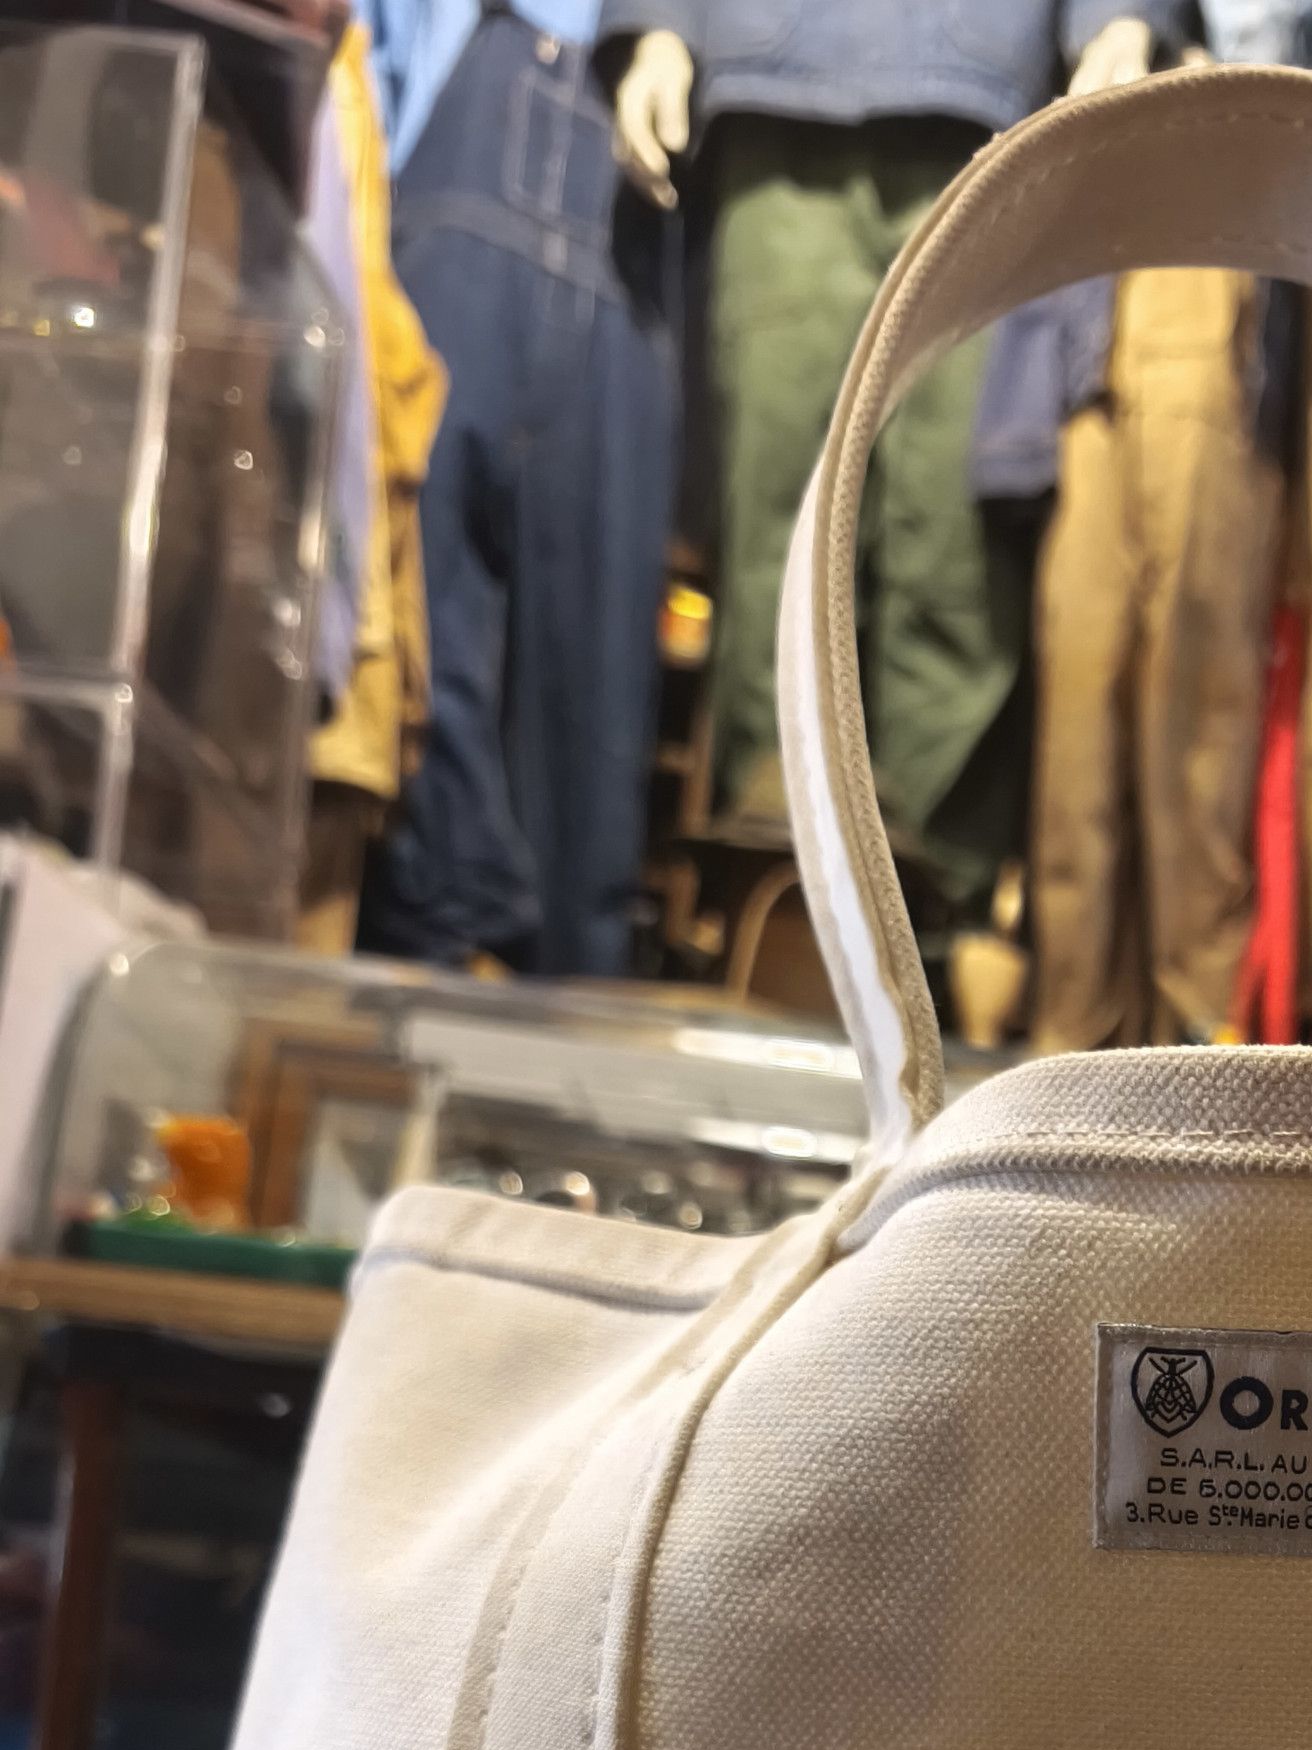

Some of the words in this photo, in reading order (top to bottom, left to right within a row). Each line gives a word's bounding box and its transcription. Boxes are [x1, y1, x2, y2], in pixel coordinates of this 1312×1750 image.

[1160, 1447, 1265, 1472] S.A.R.L.
[1270, 1454, 1308, 1475] AU
[1147, 1477, 1187, 1495] DE
